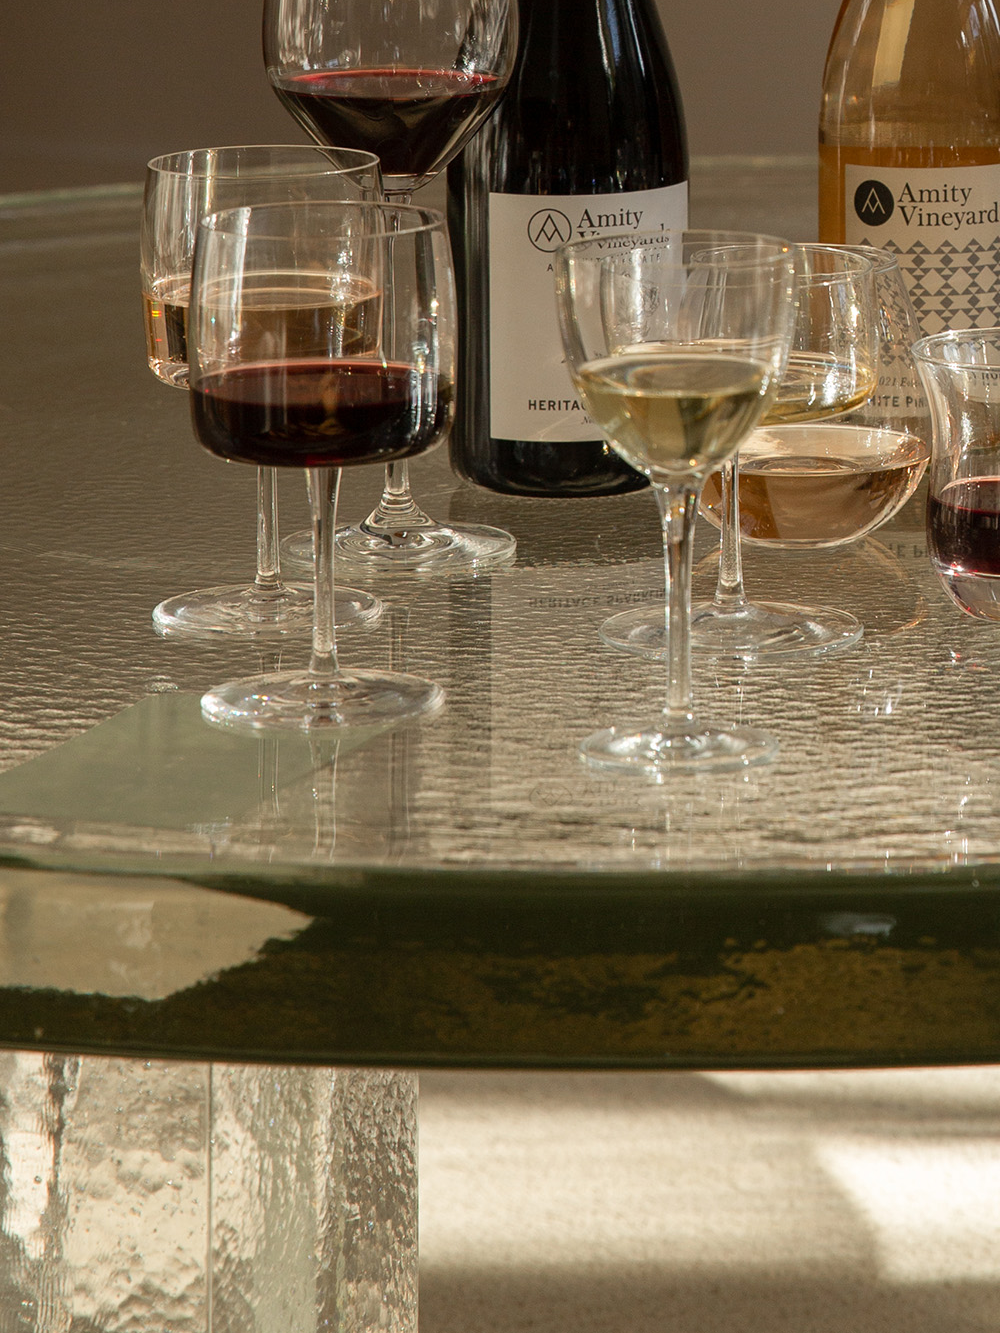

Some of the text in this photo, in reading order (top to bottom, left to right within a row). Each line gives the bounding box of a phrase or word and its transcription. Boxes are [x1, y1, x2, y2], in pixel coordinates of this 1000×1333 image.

[898, 182, 972, 207] Amity
[576, 208, 643, 229] Amity
[879, 376, 897, 387] 021
[527, 399, 588, 411] HERITA
[867, 395, 900, 407] HITE
